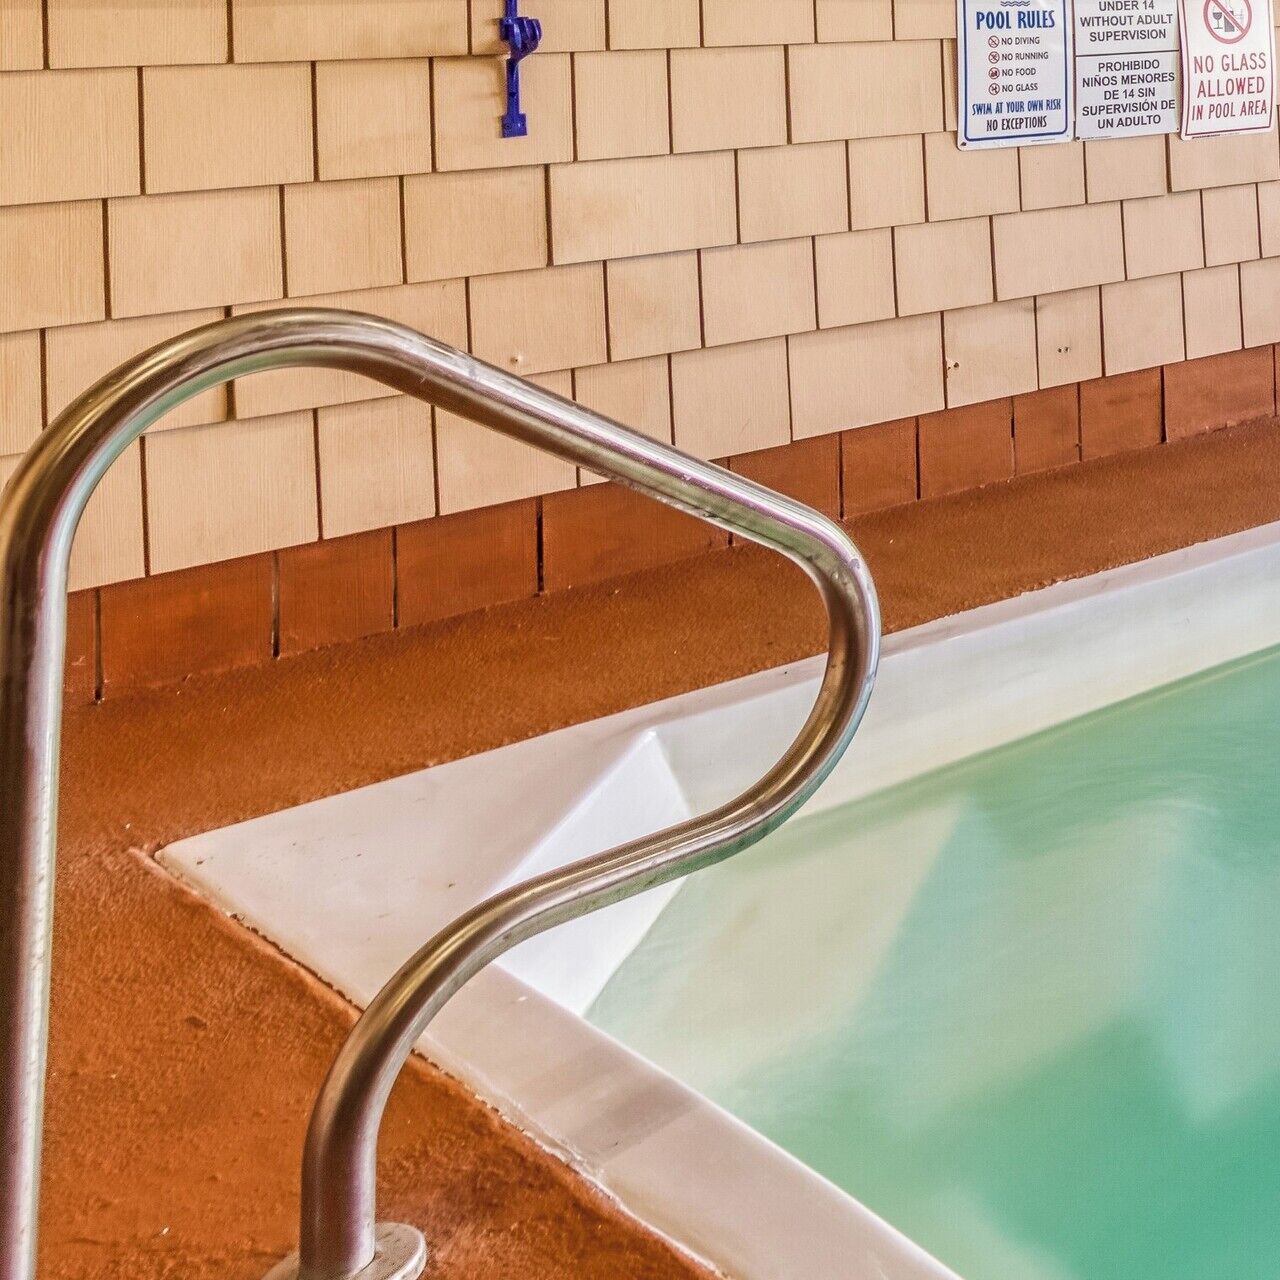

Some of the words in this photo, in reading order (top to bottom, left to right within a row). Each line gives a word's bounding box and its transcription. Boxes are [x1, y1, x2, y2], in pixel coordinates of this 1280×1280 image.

[1098, 0, 1139, 11] UNDER
[1142, 0, 1154, 10] 14
[976, 11, 1011, 30] POOL
[1018, 10, 1055, 28] RULES
[1080, 15, 1133, 27] WITHOUT
[1137, 14, 1173, 25] ADULT
[1001, 37, 1013, 45] NO
[1014, 36, 1040, 45] DIVING
[1089, 29, 1166, 42] SUPERVISION
[1001, 53, 1013, 61] NO
[1015, 52, 1049, 61] RUNNING
[1193, 55, 1214, 73] NO
[1221, 52, 1266, 71] GLASS
[1001, 69, 1013, 77] NO
[1015, 67, 1036, 76] FOOD
[1098, 59, 1160, 72] PROHIBIDO
[1082, 74, 1118, 88] NIÑOS
[1121, 72, 1175, 85] MENORES
[1002, 84, 1013, 92] NO
[1016, 83, 1038, 92] GLASS
[1104, 90, 1119, 100] DE
[1122, 89, 1134, 99] 14
[1138, 87, 1155, 98] SIN
[1197, 76, 1265, 98] ALLOWED
[972, 103, 993, 116] SWIM
[995, 102, 1003, 114] AT
[1006, 101, 1025, 113] YOUR
[1027, 100, 1043, 111] OWN
[1046, 99, 1061, 110] RISK
[1082, 99, 1158, 116] SUPERVISIÓN
[1161, 100, 1175, 110] DE
[1192, 105, 1203, 120] IN
[1208, 102, 1235, 119] POOL
[1240, 99, 1267, 116] AREA
[986, 119, 998, 131] NO
[1001, 116, 1047, 131] EXCEPTIONS
[1098, 119, 1114, 129] UN
[1116, 115, 1161, 128] ADULTO
